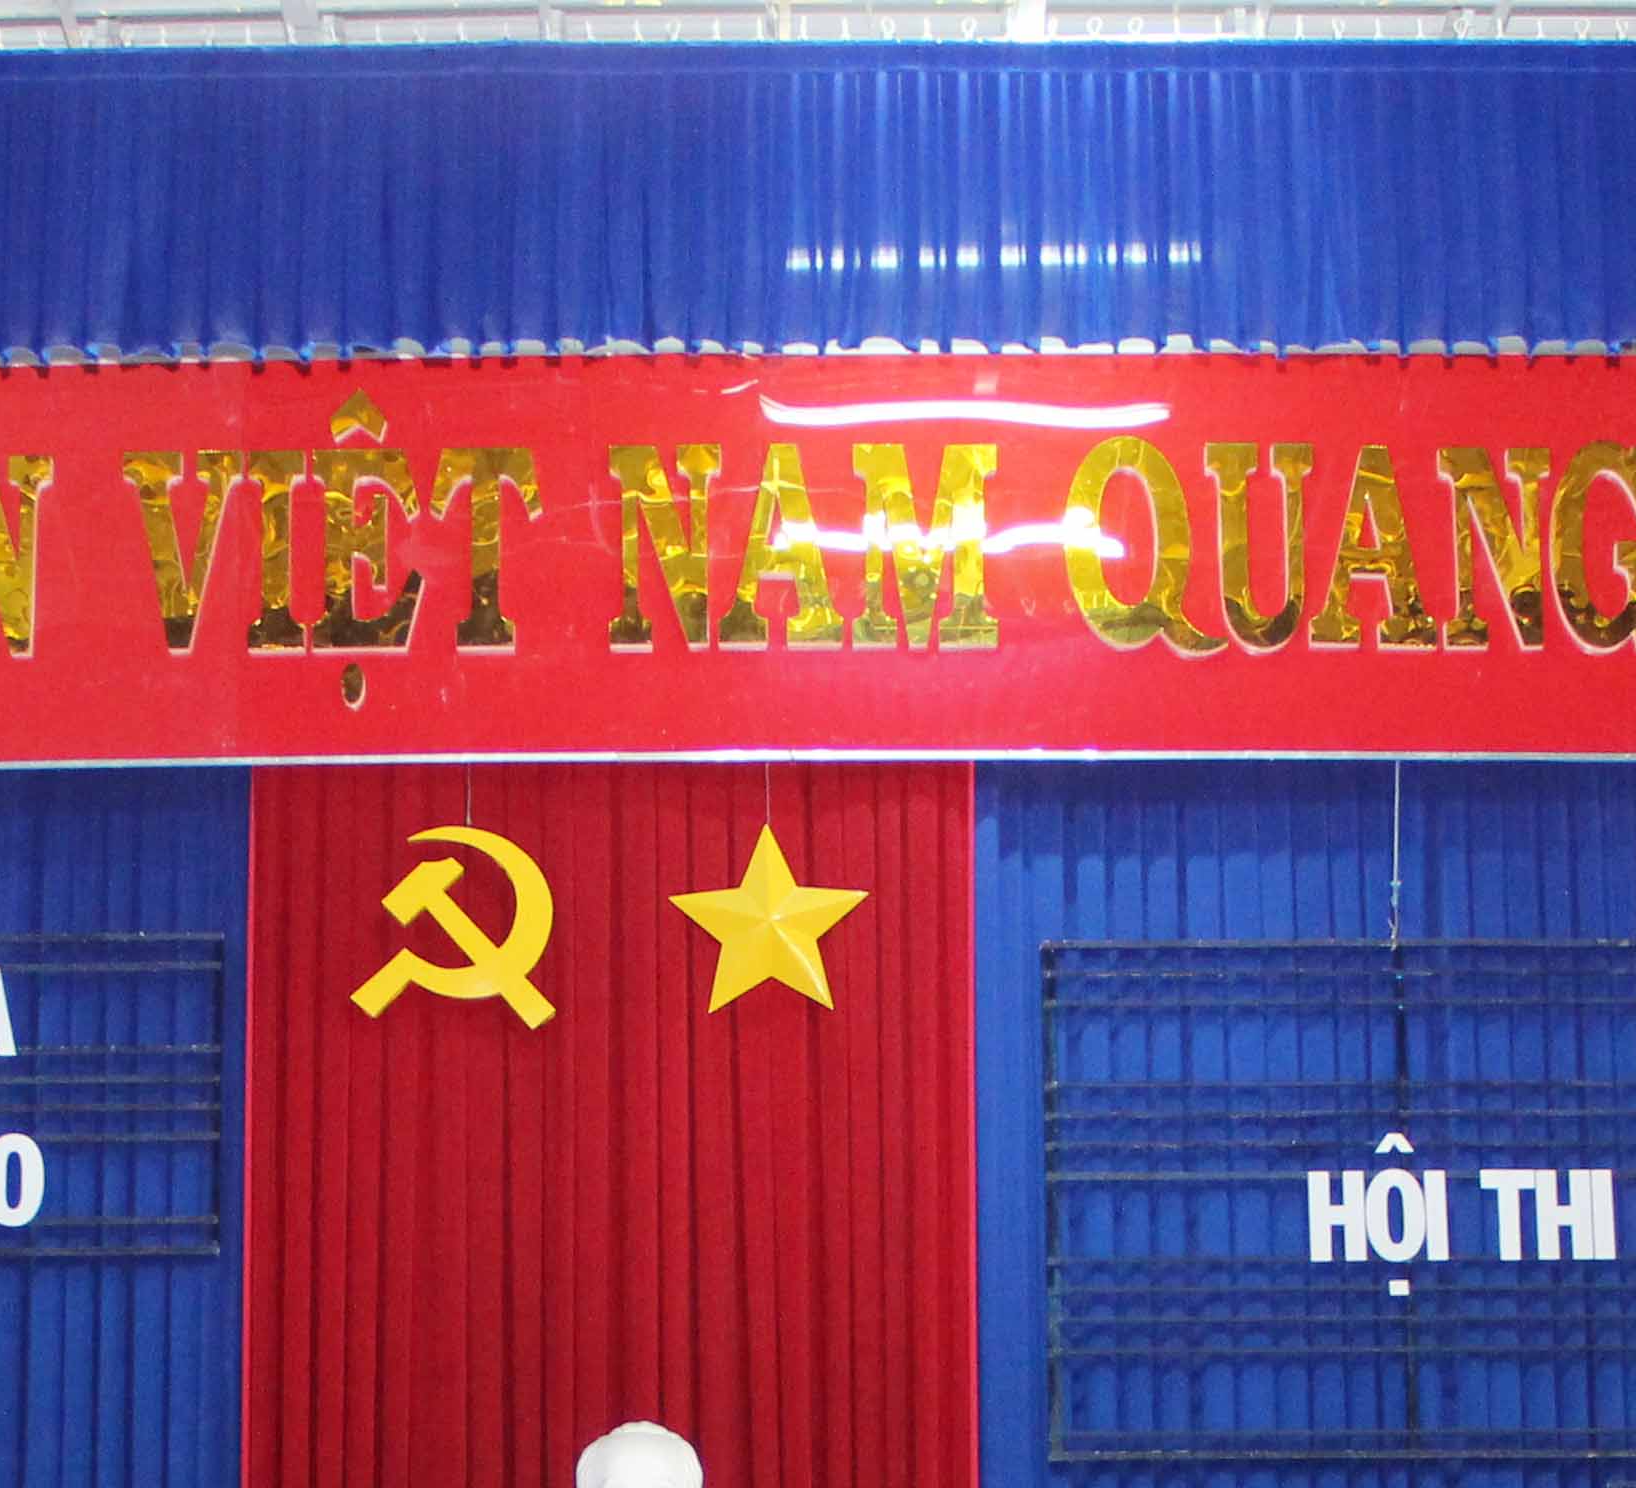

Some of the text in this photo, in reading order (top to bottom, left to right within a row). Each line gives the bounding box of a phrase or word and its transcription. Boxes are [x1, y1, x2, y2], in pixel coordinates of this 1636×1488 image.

[122, 389, 544, 712] VIỆT
[607, 440, 1001, 654] NAM
[1308, 1133, 1449, 1295] HỘI
[1480, 1169, 1616, 1260] THI
